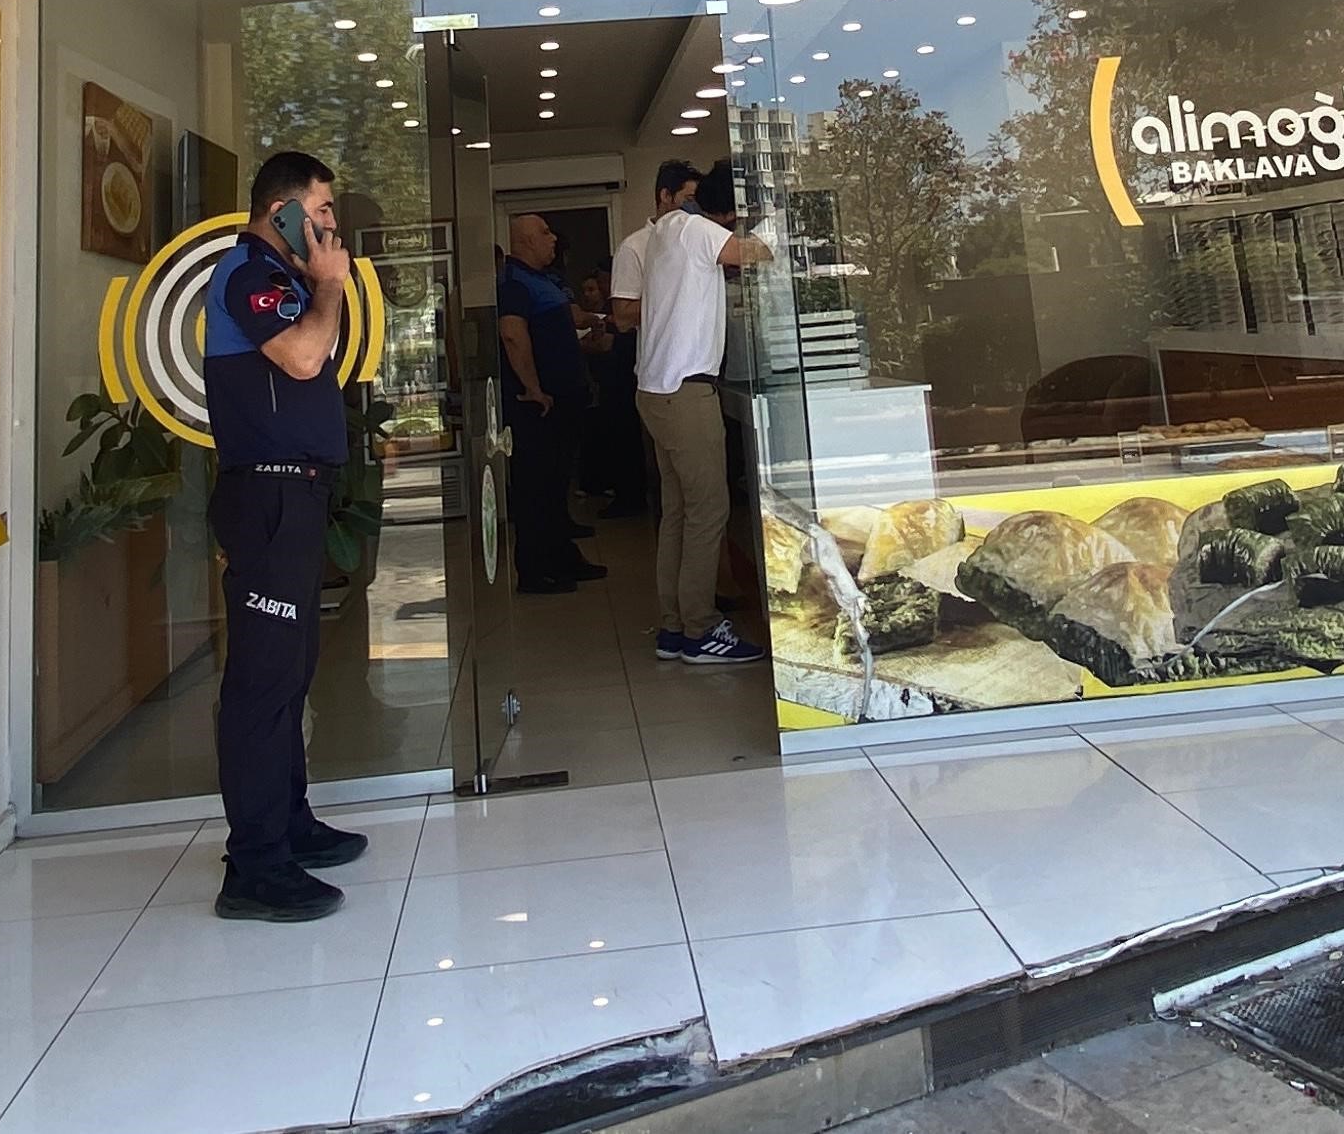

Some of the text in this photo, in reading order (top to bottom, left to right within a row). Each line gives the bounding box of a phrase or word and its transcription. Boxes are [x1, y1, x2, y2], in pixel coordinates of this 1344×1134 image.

[1171, 153, 1316, 185] BAKLAVA
[255, 464, 302, 474] ZABITA
[245, 591, 297, 620] ZABITA
